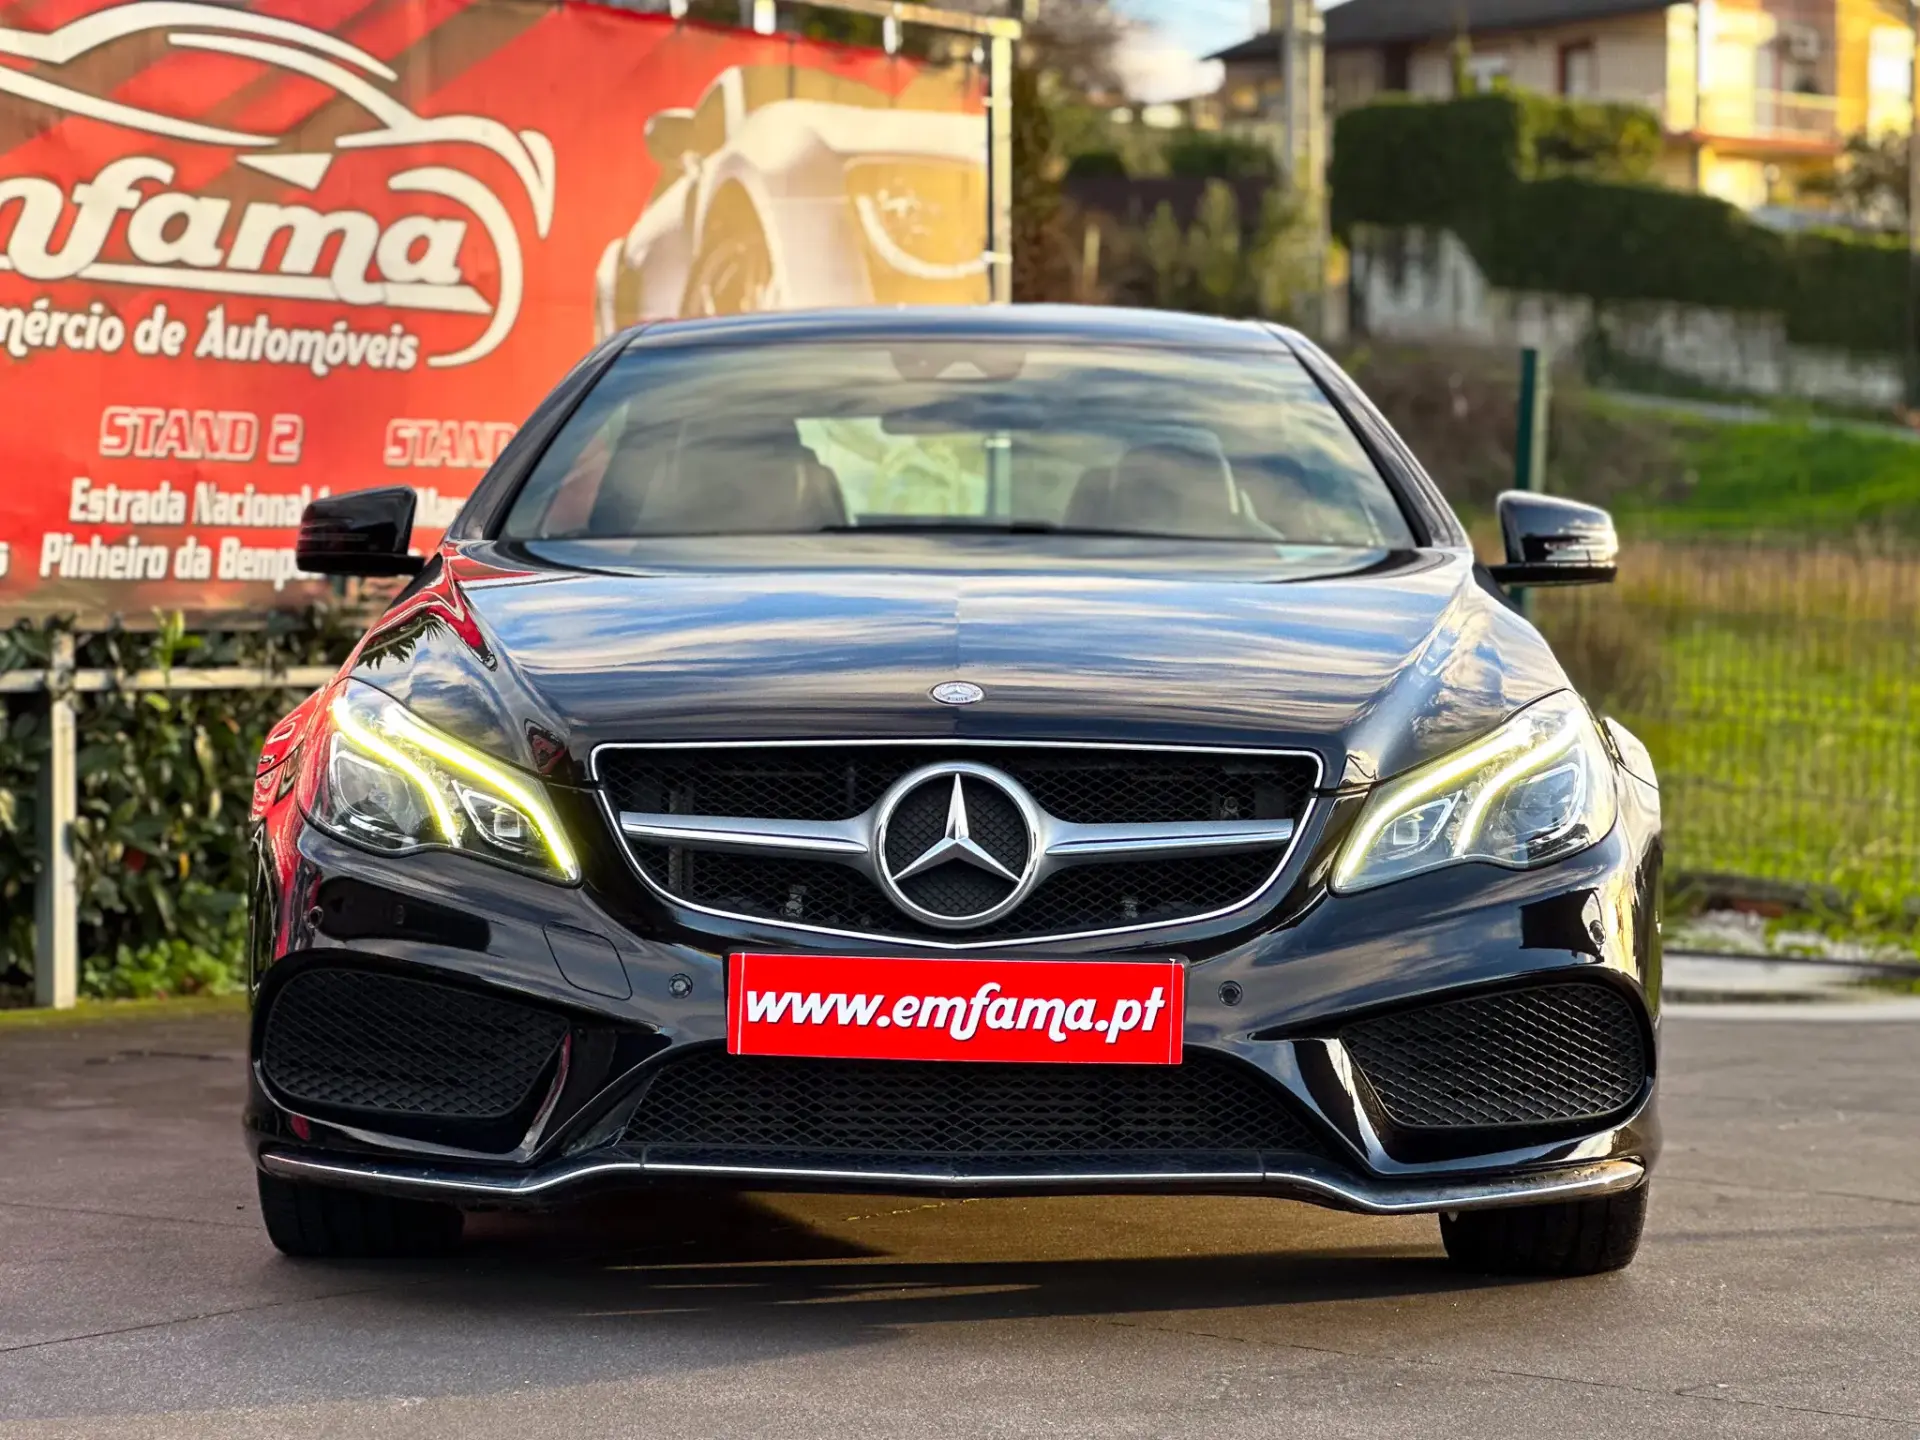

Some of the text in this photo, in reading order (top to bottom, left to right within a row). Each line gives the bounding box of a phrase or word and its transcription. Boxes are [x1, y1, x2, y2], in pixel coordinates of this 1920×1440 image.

[133, 303, 188, 356] de
[195, 304, 419, 376] Automóveis
[99, 406, 303, 463] STAND 2
[69, 477, 312, 528] Estrada Nacional
[40, 531, 167, 579] Pinheiro
[174, 537, 212, 581] da
[218, 539, 327, 591] Bemp
[746, 982, 1165, 1044] www.emfama.pt
